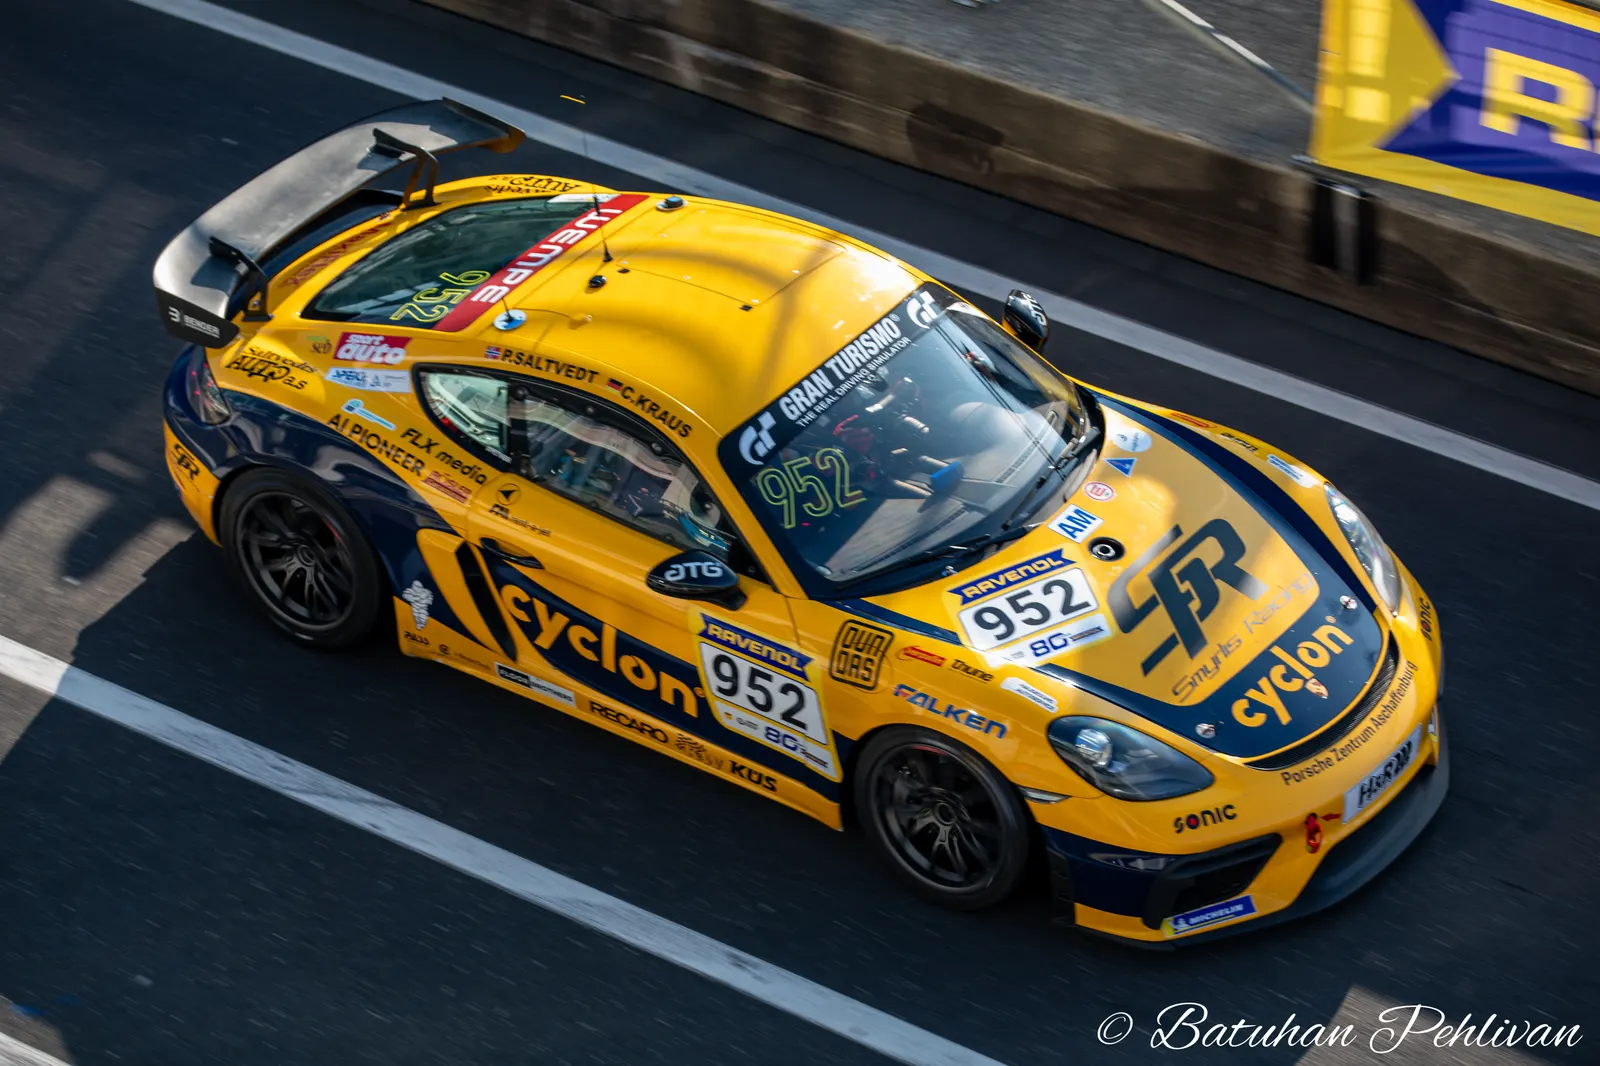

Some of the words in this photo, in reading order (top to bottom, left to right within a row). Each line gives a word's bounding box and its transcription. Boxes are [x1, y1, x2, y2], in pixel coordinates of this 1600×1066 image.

[470, 208, 624, 304] WEMPE
[389, 270, 491, 323] 952
[336, 343, 406, 365] auto
[501, 349, 599, 384] P.SALTVEDT
[778, 368, 835, 421] GRAN
[795, 411, 816, 428] THE
[813, 395, 839, 414] REAL
[837, 369, 873, 396] DRIVING
[867, 336, 911, 371] SIMULATOR
[620, 386, 693, 438] C.KRAUS
[349, 423, 426, 477] PIONEER
[400, 428, 440, 455] FLX
[435, 450, 489, 485] media
[756, 447, 867, 529] 952
[1060, 508, 1097, 538] AM
[962, 555, 1066, 600] RAVENOL
[1243, 573, 1315, 634] Racing
[971, 579, 1091, 641] 952
[501, 584, 700, 718] cyclon
[707, 624, 805, 672] RAVENOL
[1231, 621, 1355, 727] cyclon
[712, 654, 808, 731] 952
[893, 683, 1008, 739] FALKEN
[590, 700, 669, 744] RECARO
[1280, 756, 1334, 786] Porsche
[1333, 726, 1377, 763] Zentrum
[1370, 660, 1419, 730] Aschaffenburg
[1189, 903, 1244, 925] MICHELIN
